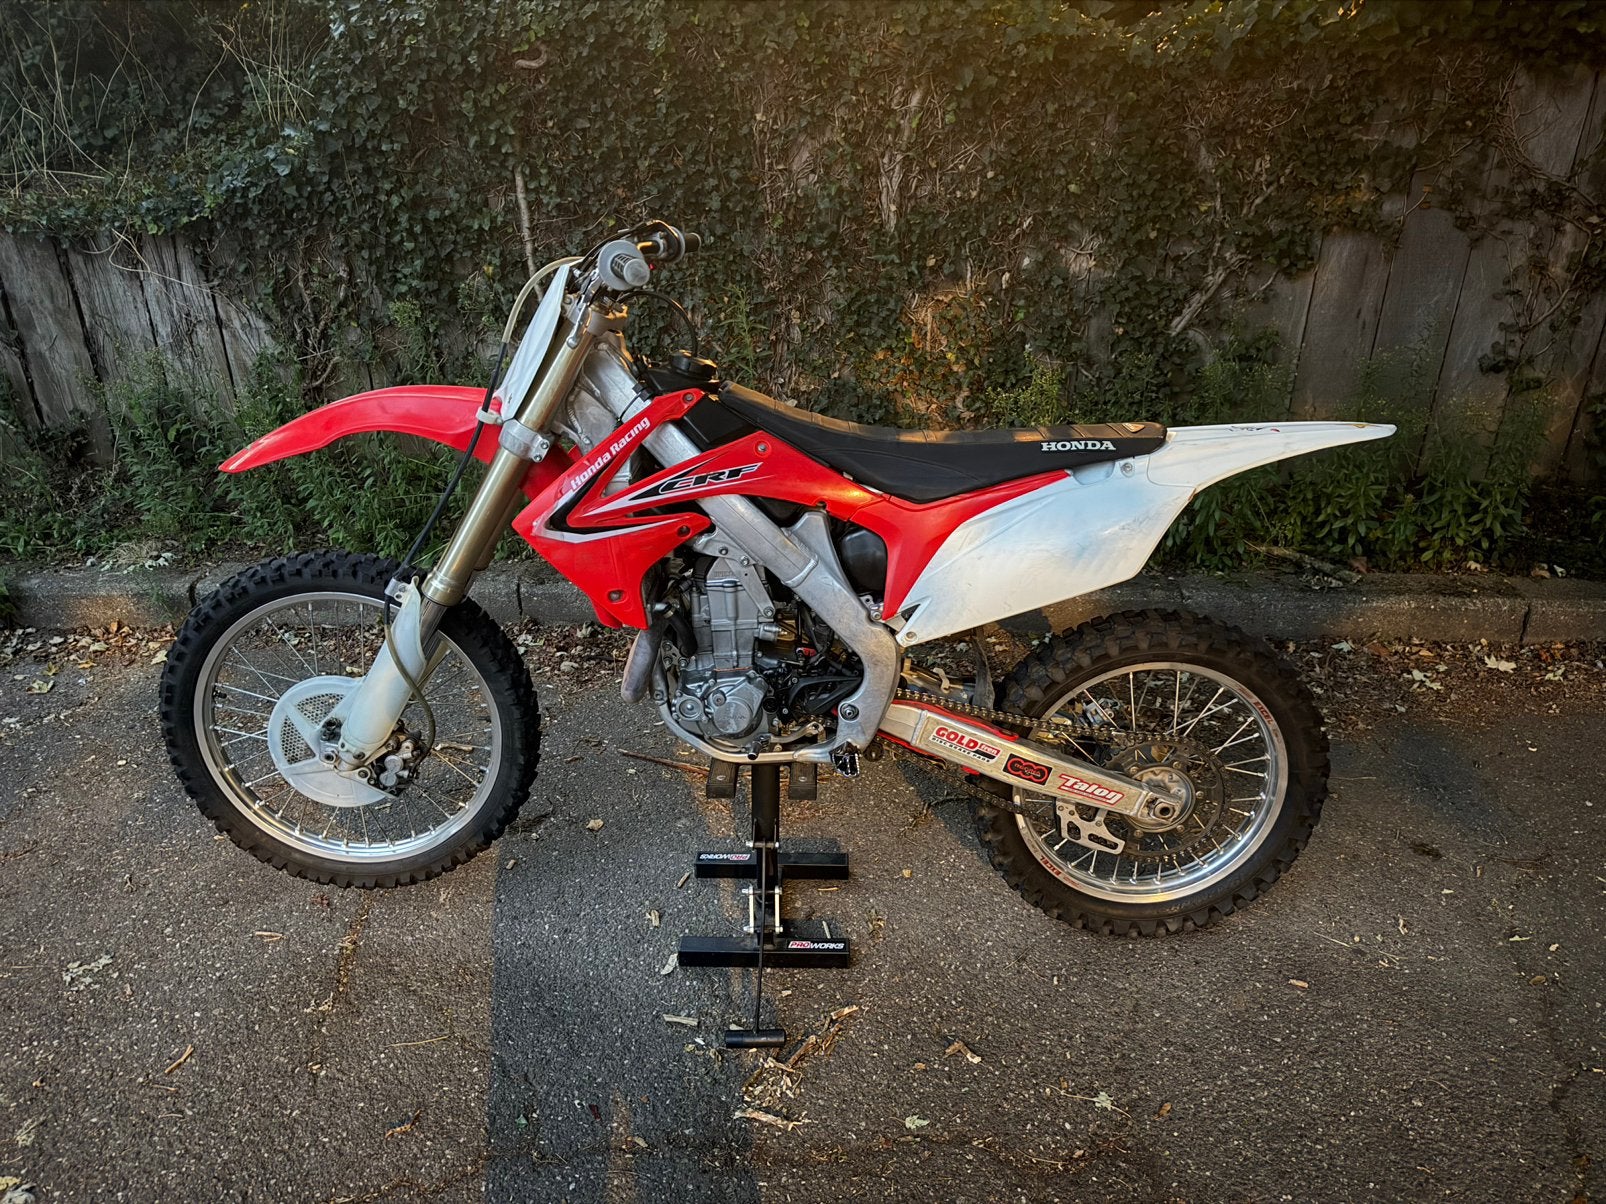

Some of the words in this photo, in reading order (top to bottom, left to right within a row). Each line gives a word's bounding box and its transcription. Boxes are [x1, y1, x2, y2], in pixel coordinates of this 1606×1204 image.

[571, 452, 612, 490] Honda
[610, 417, 651, 456] Racing
[1040, 440, 1117, 451] HONDA
[659, 462, 763, 494] CRF
[935, 726, 979, 750] GOLD
[1059, 773, 1125, 805] Talon
